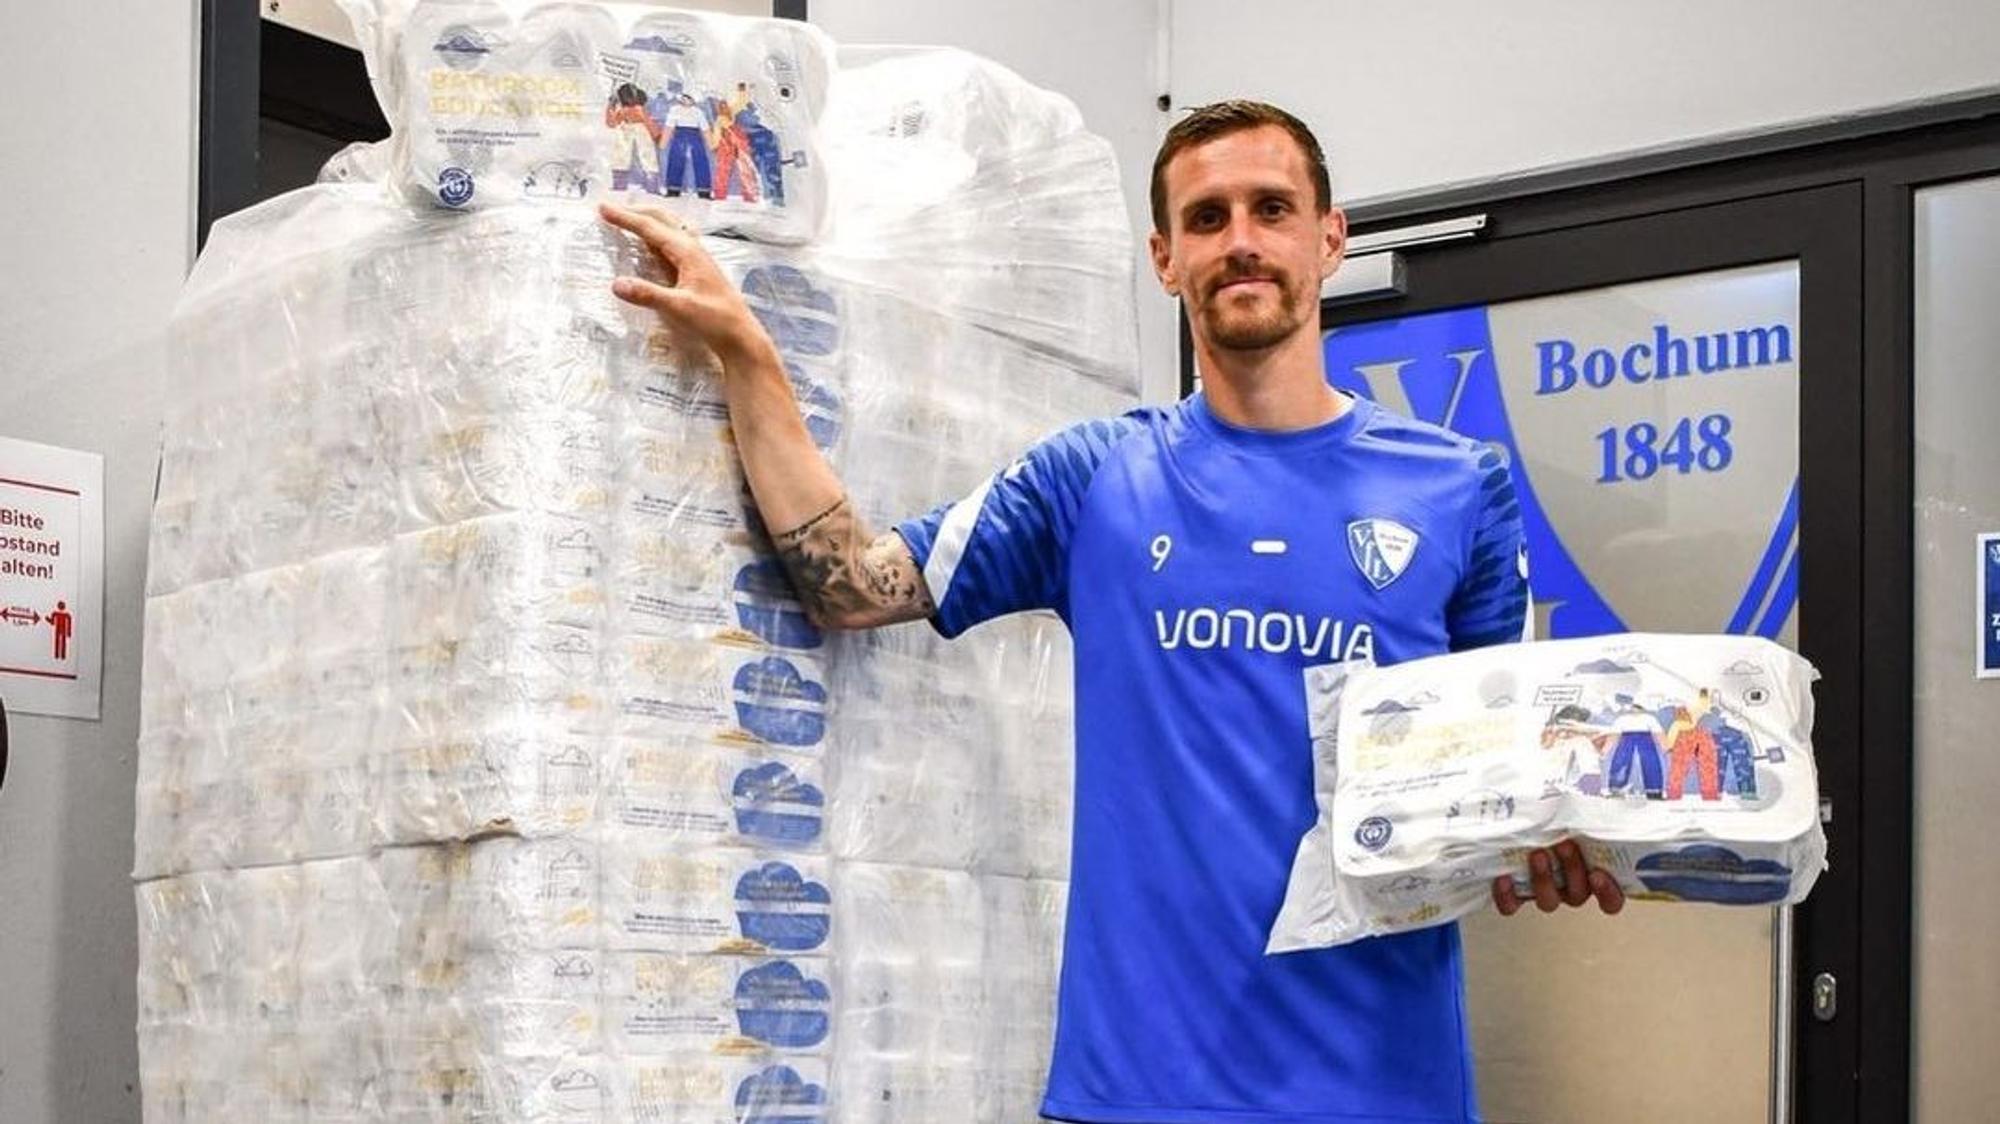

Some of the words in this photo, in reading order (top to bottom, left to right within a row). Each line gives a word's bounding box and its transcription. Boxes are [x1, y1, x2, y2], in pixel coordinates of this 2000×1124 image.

[1535, 324, 1792, 395] Bochum
[1597, 414, 1733, 485] 1848
[0, 508, 44, 531] Bitte
[1151, 534, 1172, 572] 9
